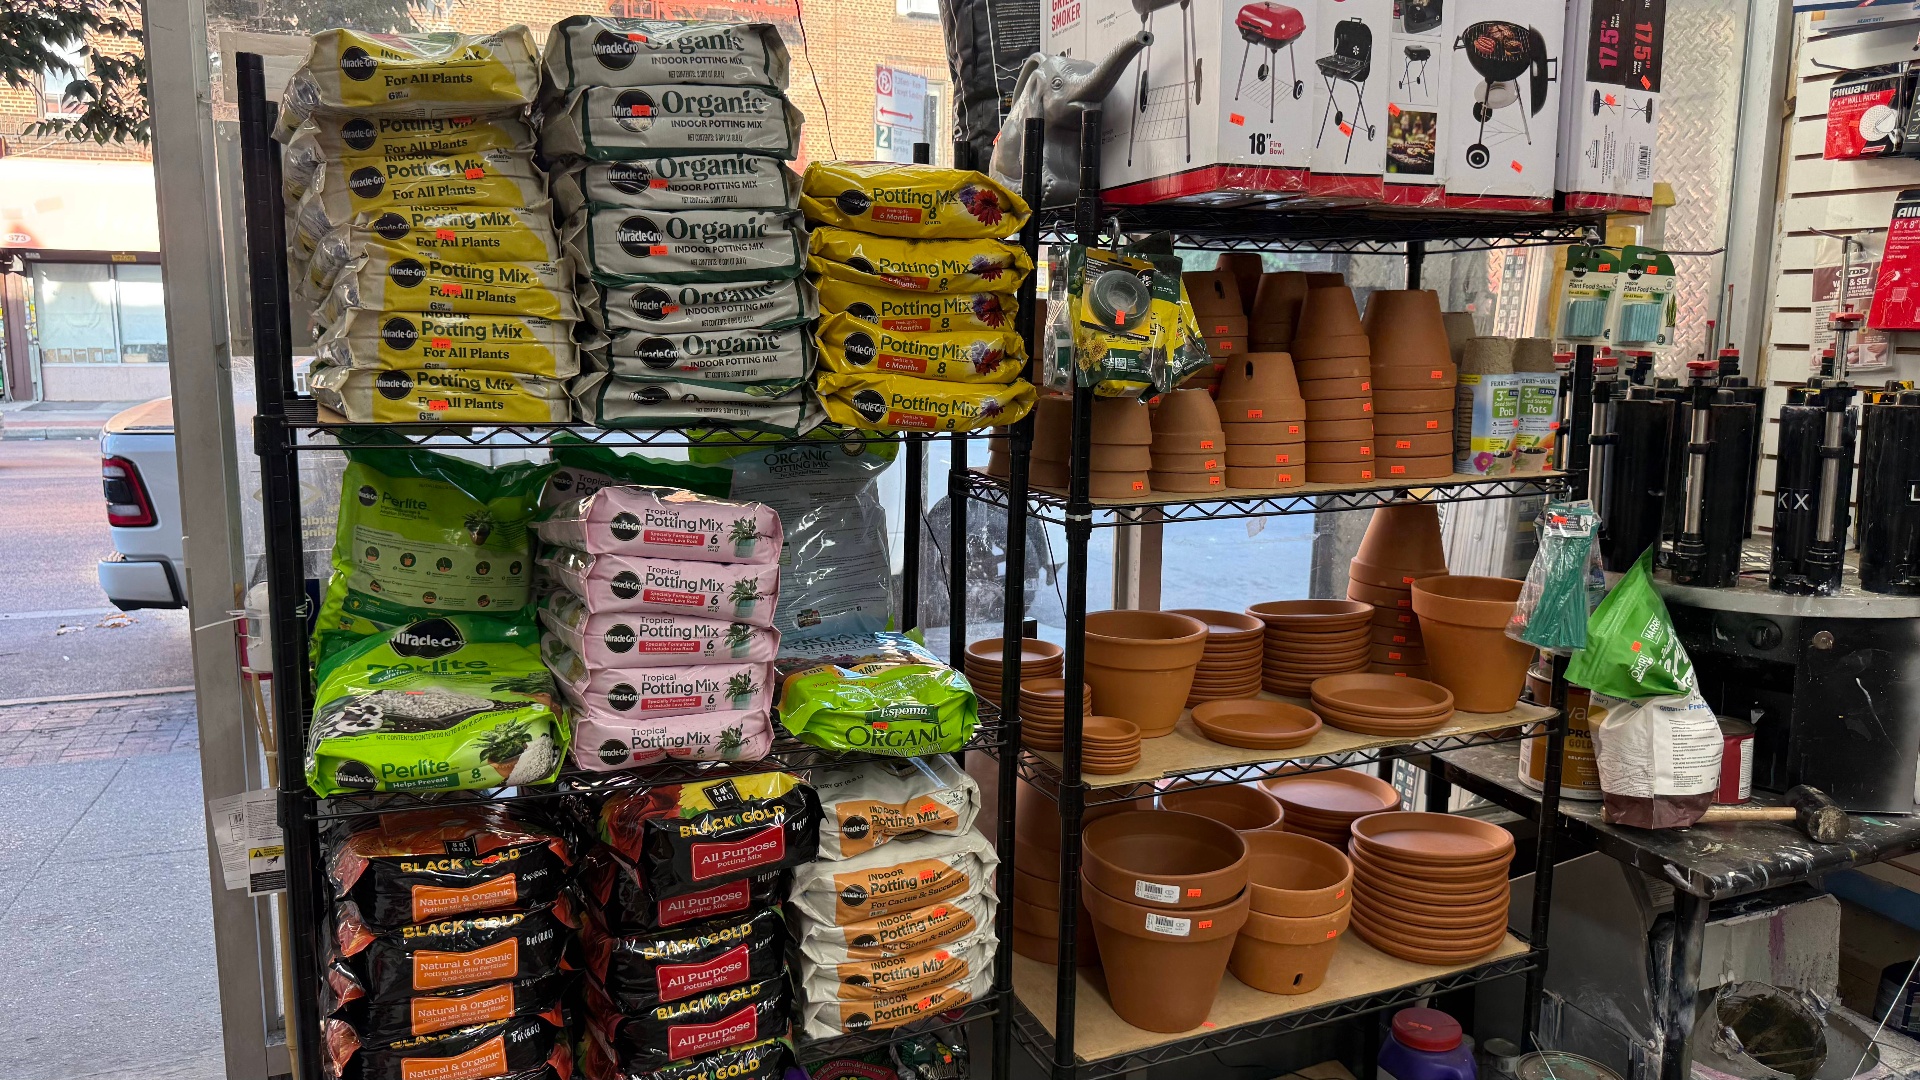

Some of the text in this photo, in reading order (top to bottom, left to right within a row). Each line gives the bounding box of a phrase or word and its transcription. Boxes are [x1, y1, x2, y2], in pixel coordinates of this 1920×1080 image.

[1051, 2, 1081, 31] SMOKER
[651, 56, 744, 65] INDOOR POTTING MIX
[385, 73, 472, 86] For All Plants
[1832, 84, 1868, 97] Allway
[662, 91, 765, 118] Organic
[1848, 96, 1862, 104] WALL
[1863, 93, 1880, 102] PATCH
[671, 120, 707, 128] INDOOR
[709, 120, 745, 128] POTTING
[879, 126, 889, 147] 2
[656, 154, 760, 180] Organic
[929, 207, 937, 220] 8
[666, 212, 768, 244] Organic
[675, 242, 764, 254] INDOOR POTTING MIX
[430, 262, 530, 283] Potting Mix
[1849, 278, 1855, 286] &
[422, 321, 522, 340] Potting Mix
[892, 362, 919, 371] Months
[418, 372, 514, 392] Potting Mix
[469, 398, 504, 410] Plants
[1499, 407, 1513, 416] Pots
[1527, 404, 1546, 413] Pots
[903, 419, 928, 427] Months
[764, 450, 832, 466] ORGANIC
[769, 461, 810, 473] POTTING
[382, 491, 428, 510] Perlite
[1778, 492, 1809, 511] K X
[711, 534, 718, 544] 6
[647, 566, 680, 576] Tropical
[711, 594, 718, 605] 6
[640, 616, 674, 625] Tropical
[707, 640, 714, 650] 6
[880, 707, 928, 718] Espoma
[846, 722, 948, 746] ORGANIC
[1568, 729, 1590, 737] PRO
[1569, 739, 1591, 749] GOLD
[381, 760, 449, 779] Perlite
[471, 768, 481, 779] 8
[393, 776, 449, 789] Helps Prevent
[680, 806, 786, 838] BLACK GOLD
[701, 839, 777, 865] All Purpose
[868, 869, 905, 881] INDOOR
[419, 887, 512, 906] Natural & Organic
[870, 875, 965, 910] For Cactus & Succulent
[667, 891, 742, 912] All Purpose
[877, 912, 912, 930] INDOOR
[882, 917, 973, 952] For Cactus & Succulent
[420, 959, 459, 971] Natural
[472, 952, 512, 966] Organic
[424, 970, 449, 978] Potting
[480, 961, 509, 971] Fertilizer
[667, 960, 742, 988] All Purpose
[894, 962, 965, 992] Cactus & Succulent
[657, 984, 761, 1020] BLACK GOLD
[932, 994, 968, 1017] Succulent
[476, 1004, 505, 1016] Fertilizer
[454, 1069, 468, 1077] Plus
[470, 1062, 499, 1074] Fertilizer
